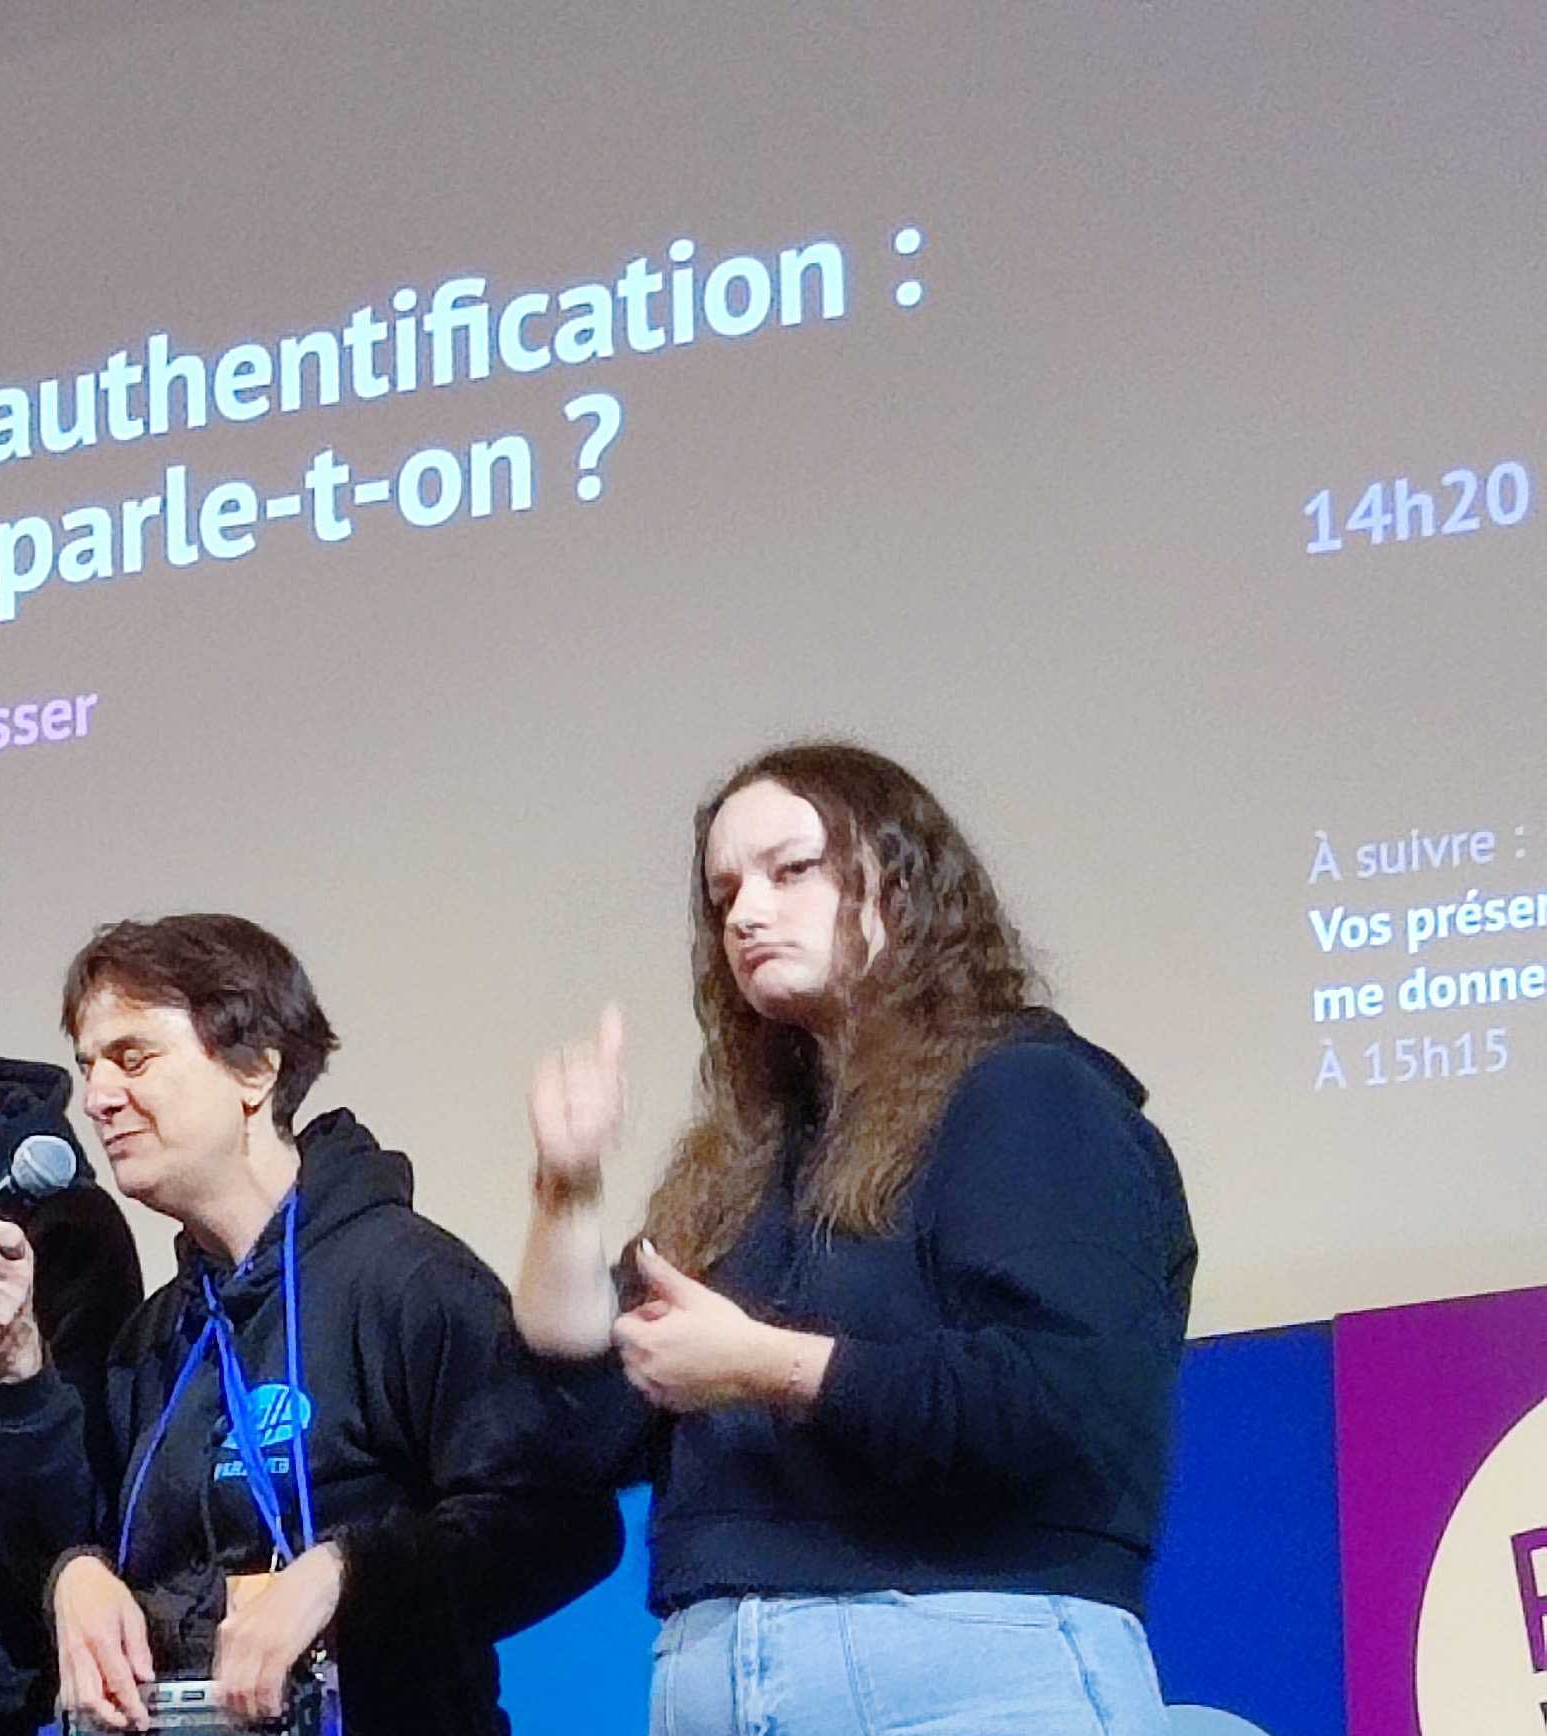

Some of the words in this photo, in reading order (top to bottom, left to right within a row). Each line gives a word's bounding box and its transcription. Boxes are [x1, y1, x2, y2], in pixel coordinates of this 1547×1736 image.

[894, 227, 922, 306] :
[564, 392, 622, 501] ?
[1303, 460, 1530, 555] 14h20
[1308, 828, 1343, 884] À
[1356, 827, 1496, 879] suivre
[1308, 905, 1392, 952] Vos
[1313, 972, 1385, 1022] me
[1314, 1037, 1347, 1091] À
[1362, 1026, 1509, 1087] 15h15
